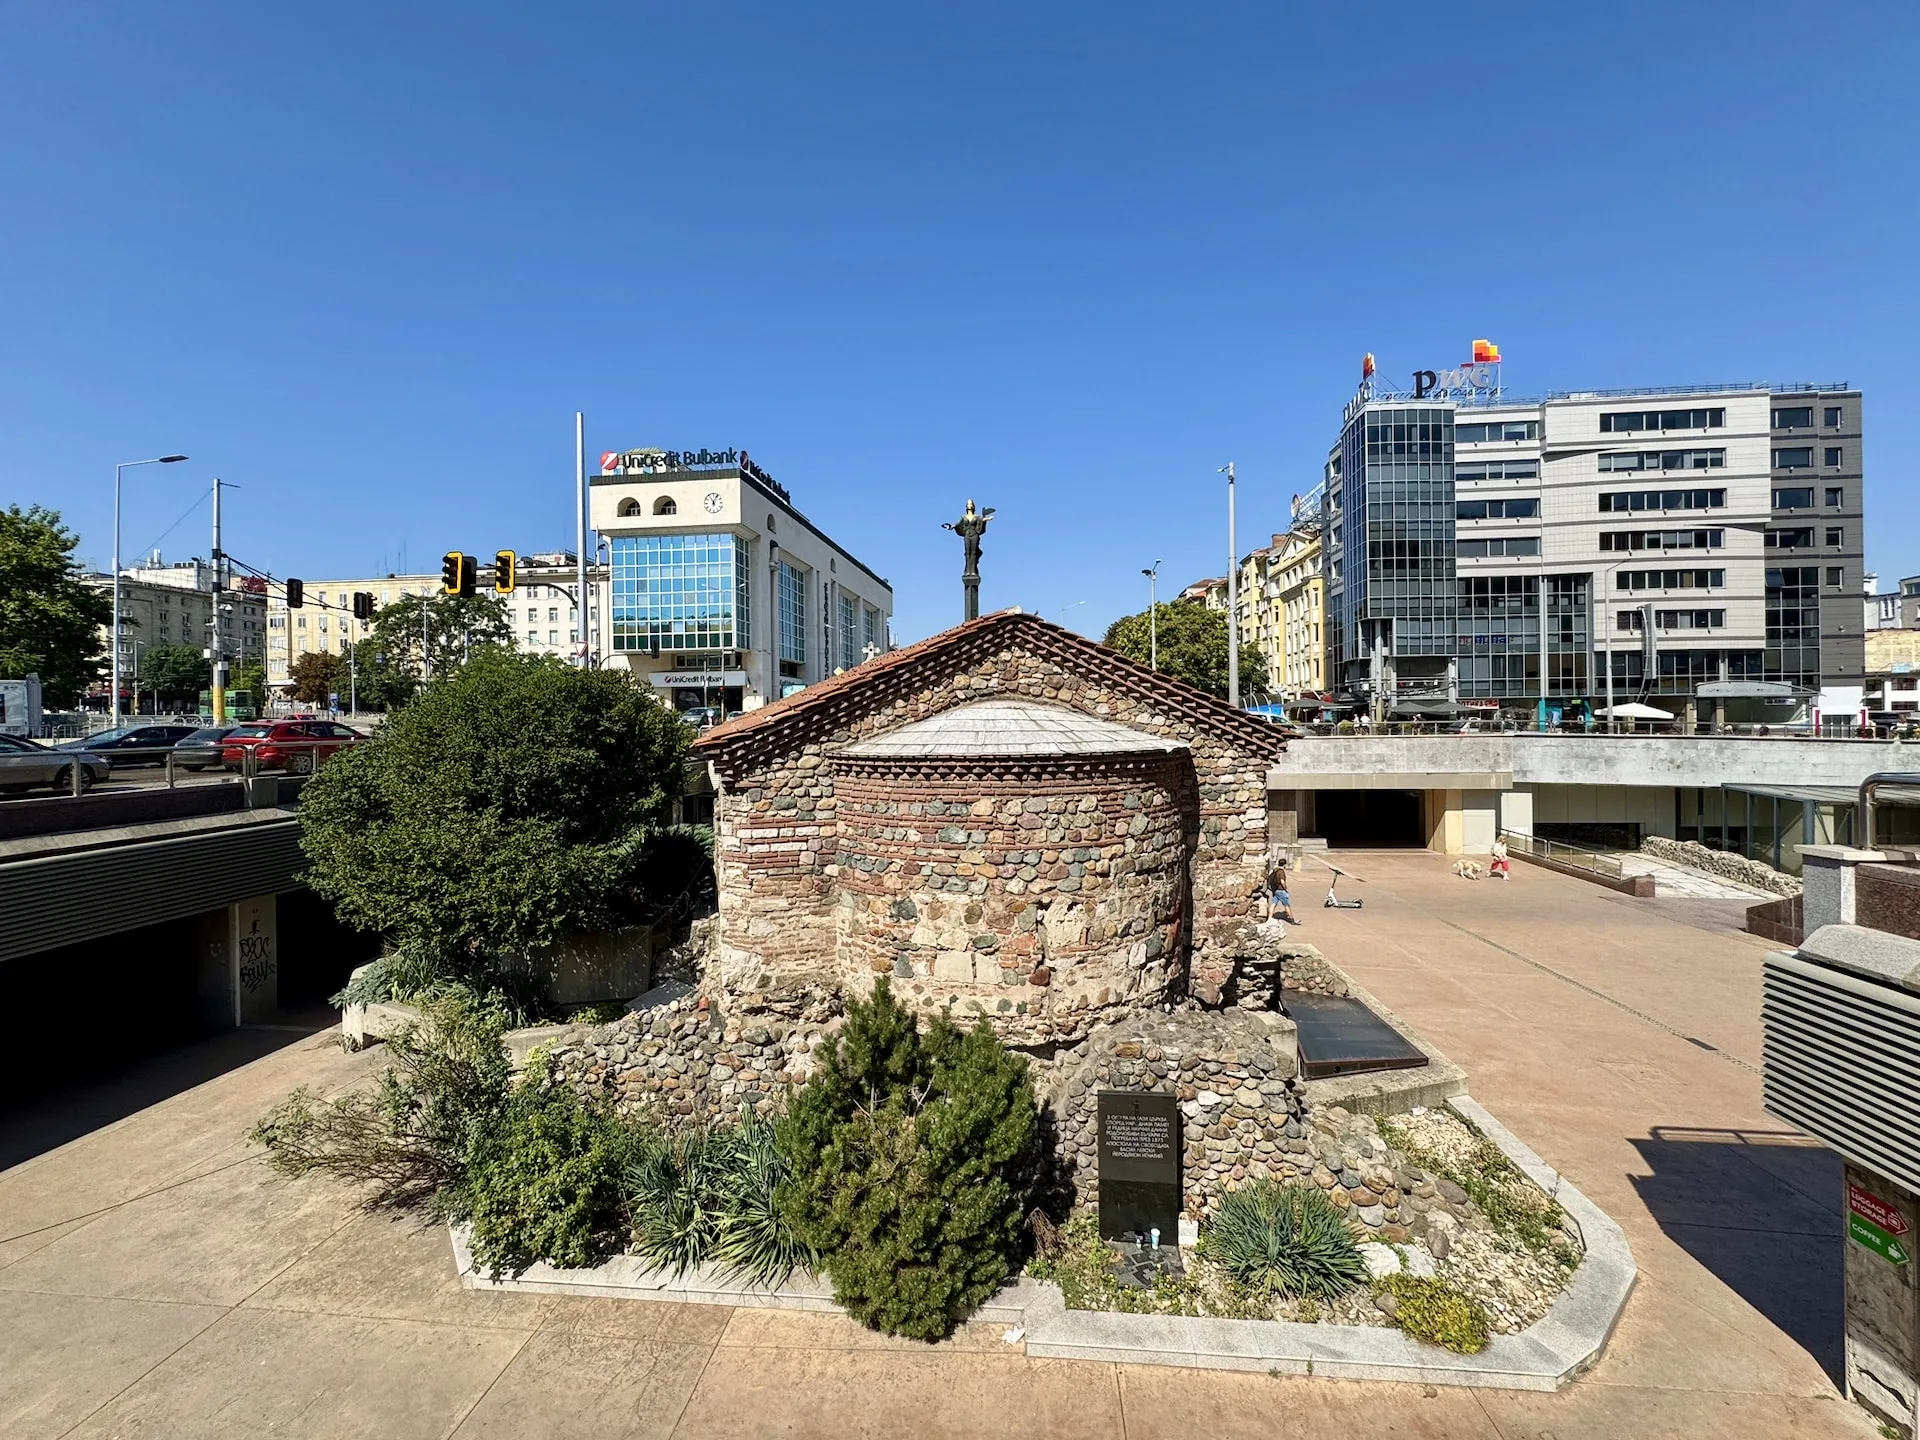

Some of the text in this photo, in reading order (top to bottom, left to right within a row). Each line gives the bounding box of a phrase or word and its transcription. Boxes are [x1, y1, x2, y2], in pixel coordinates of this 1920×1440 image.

[1412, 366, 1489, 399] pwc
[623, 446, 738, 469] UniCredit Bulbank
[671, 675, 722, 683] UniCredit Blban
[1851, 1191, 1887, 1216] LUGGAGE
[1851, 1199, 1888, 1226] STORAGE
[1851, 1223, 1881, 1246] COFFEE
